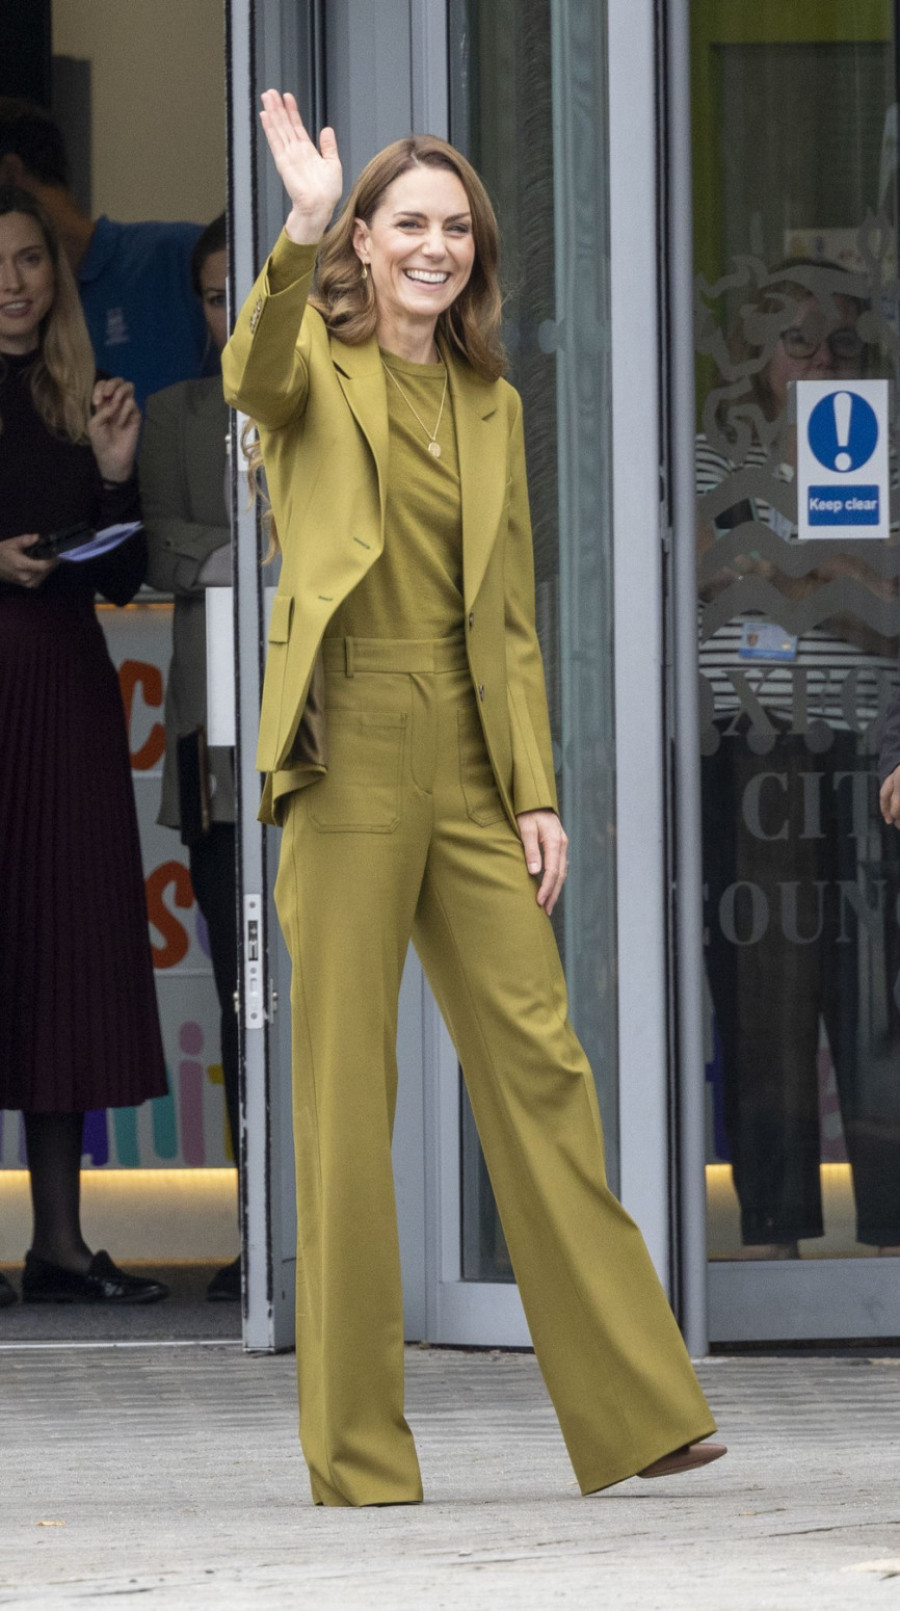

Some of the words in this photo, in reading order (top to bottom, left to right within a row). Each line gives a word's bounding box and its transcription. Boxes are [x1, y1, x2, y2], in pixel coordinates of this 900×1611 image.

[809, 497, 843, 514] Keep
[844, 497, 877, 511] clear
[702, 880, 900, 946] OUN
